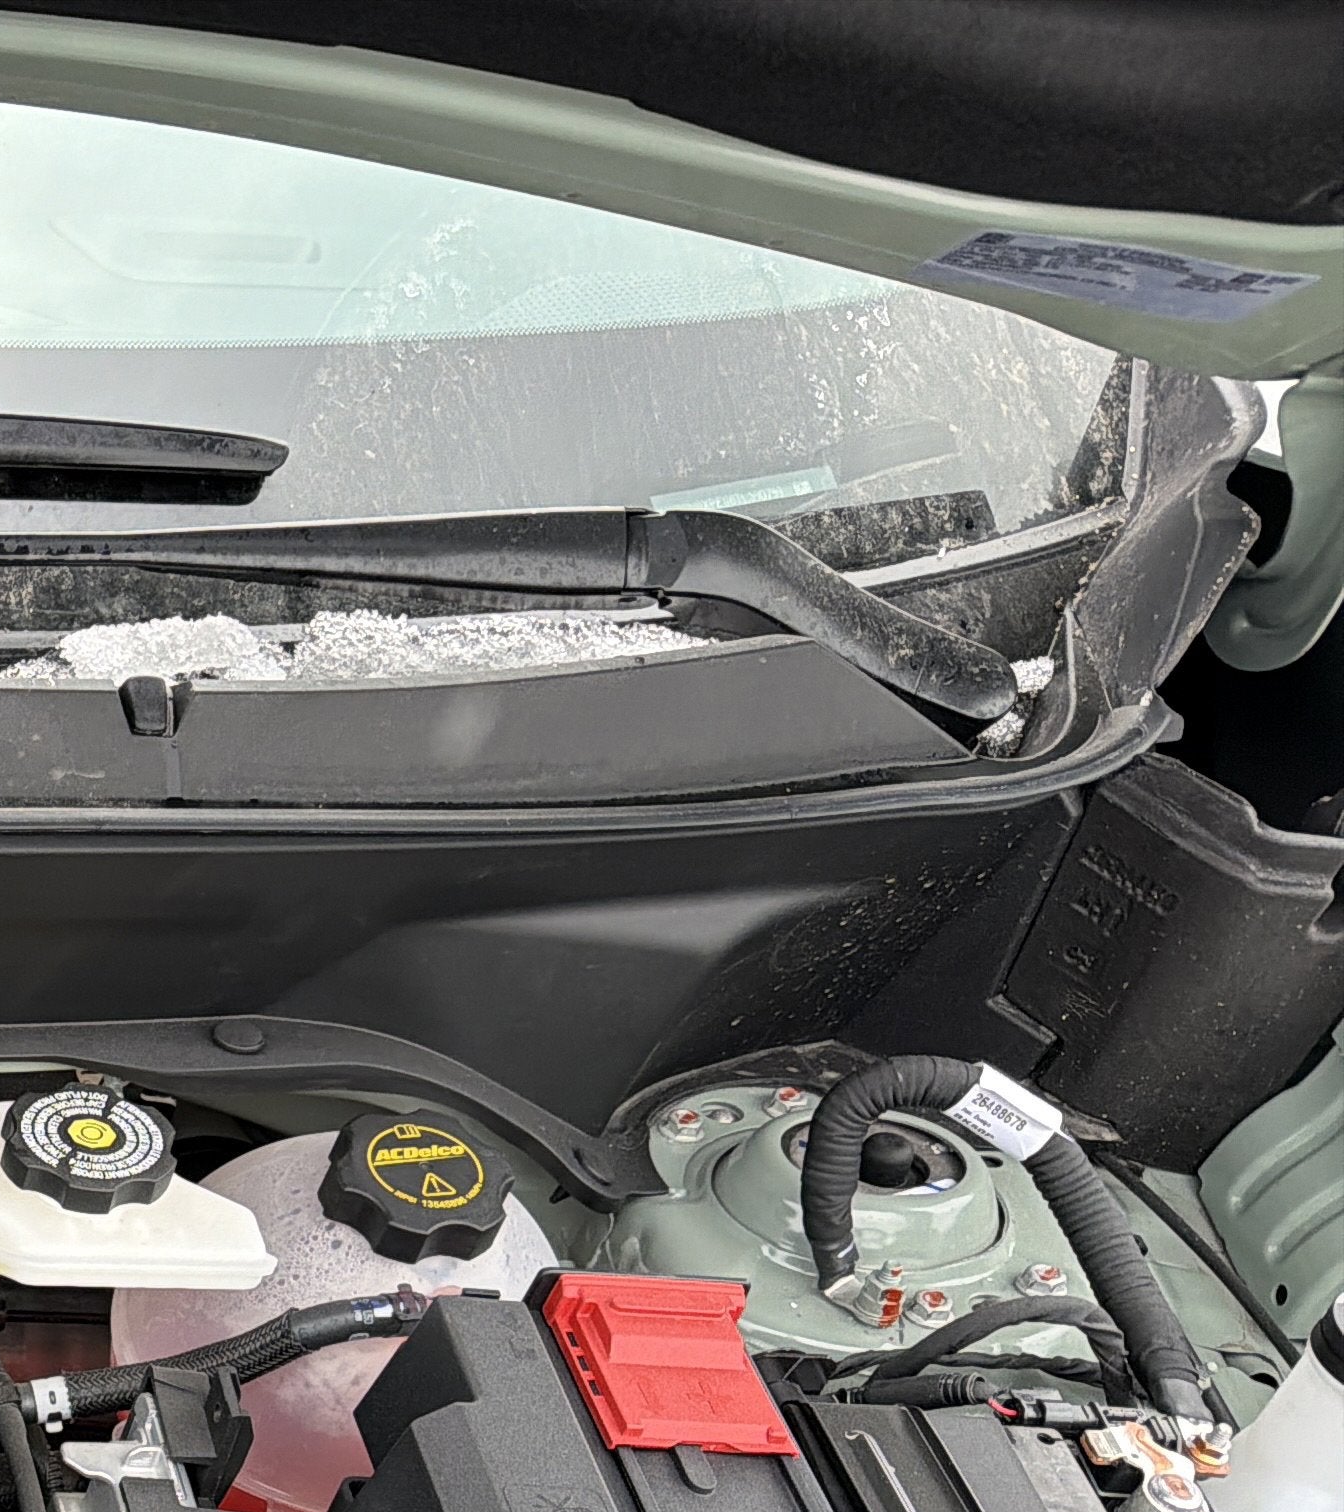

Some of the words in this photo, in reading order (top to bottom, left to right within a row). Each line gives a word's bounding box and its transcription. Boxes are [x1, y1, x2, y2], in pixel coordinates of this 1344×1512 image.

[53, 1091, 82, 1101] FLUID
[88, 1092, 108, 1102] DOT
[33, 1095, 56, 1110] FROM
[50, 1099, 85, 1110] BEFORE
[85, 1100, 106, 1108] CAP
[21, 1110, 35, 1132] SEALED
[42, 1144, 66, 1161] ONLY
[374, 1144, 466, 1163] ACDelco
[75, 1160, 91, 1169] DOT
